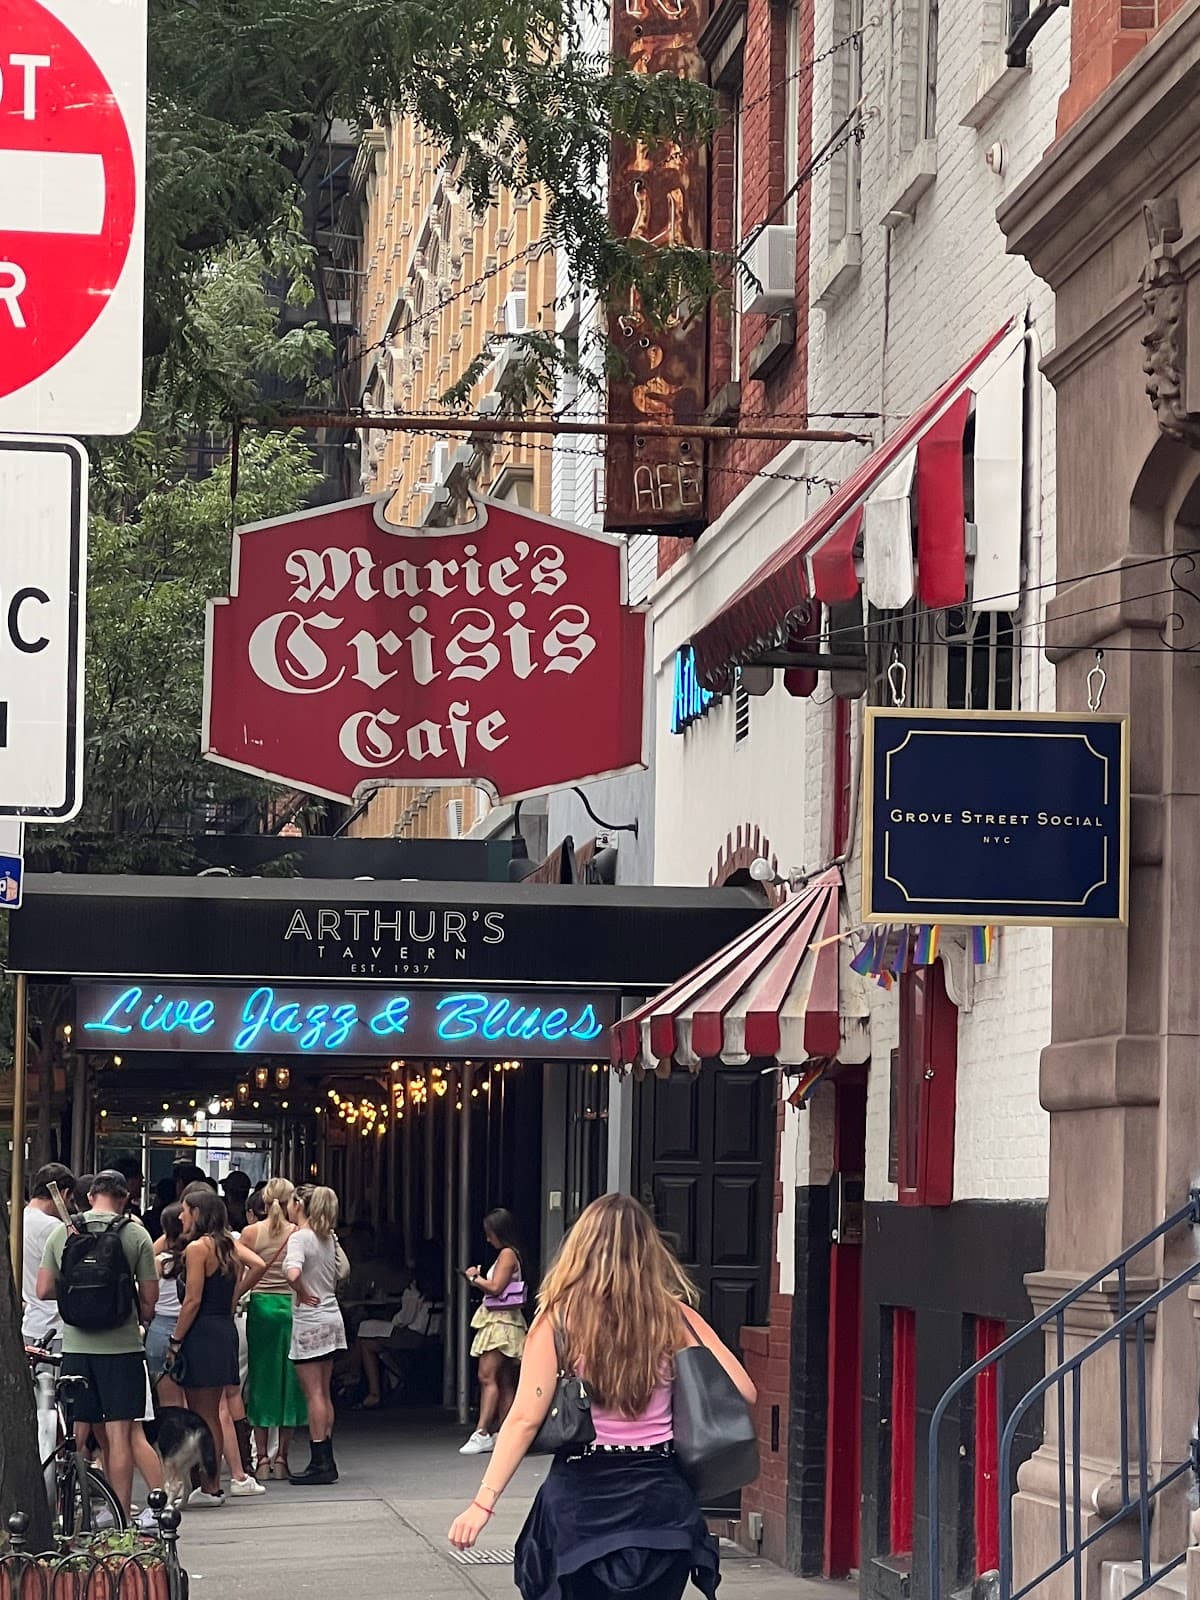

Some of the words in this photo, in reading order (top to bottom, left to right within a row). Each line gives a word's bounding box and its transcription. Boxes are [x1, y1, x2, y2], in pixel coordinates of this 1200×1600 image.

[285, 541, 568, 604] Marie's
[248, 601, 597, 695] Crisis
[338, 700, 510, 769] Cafe
[983, 835, 1011, 845] NYC
[284, 908, 506, 945] ARTHUR'S
[317, 945, 467, 961] TAVERN
[351, 963, 383, 974] EST.
[394, 964, 430, 975] 1937
[83, 986, 216, 1035] Live
[233, 986, 360, 1050] Jazz
[369, 996, 412, 1036] &
[435, 993, 603, 1041] Blues
